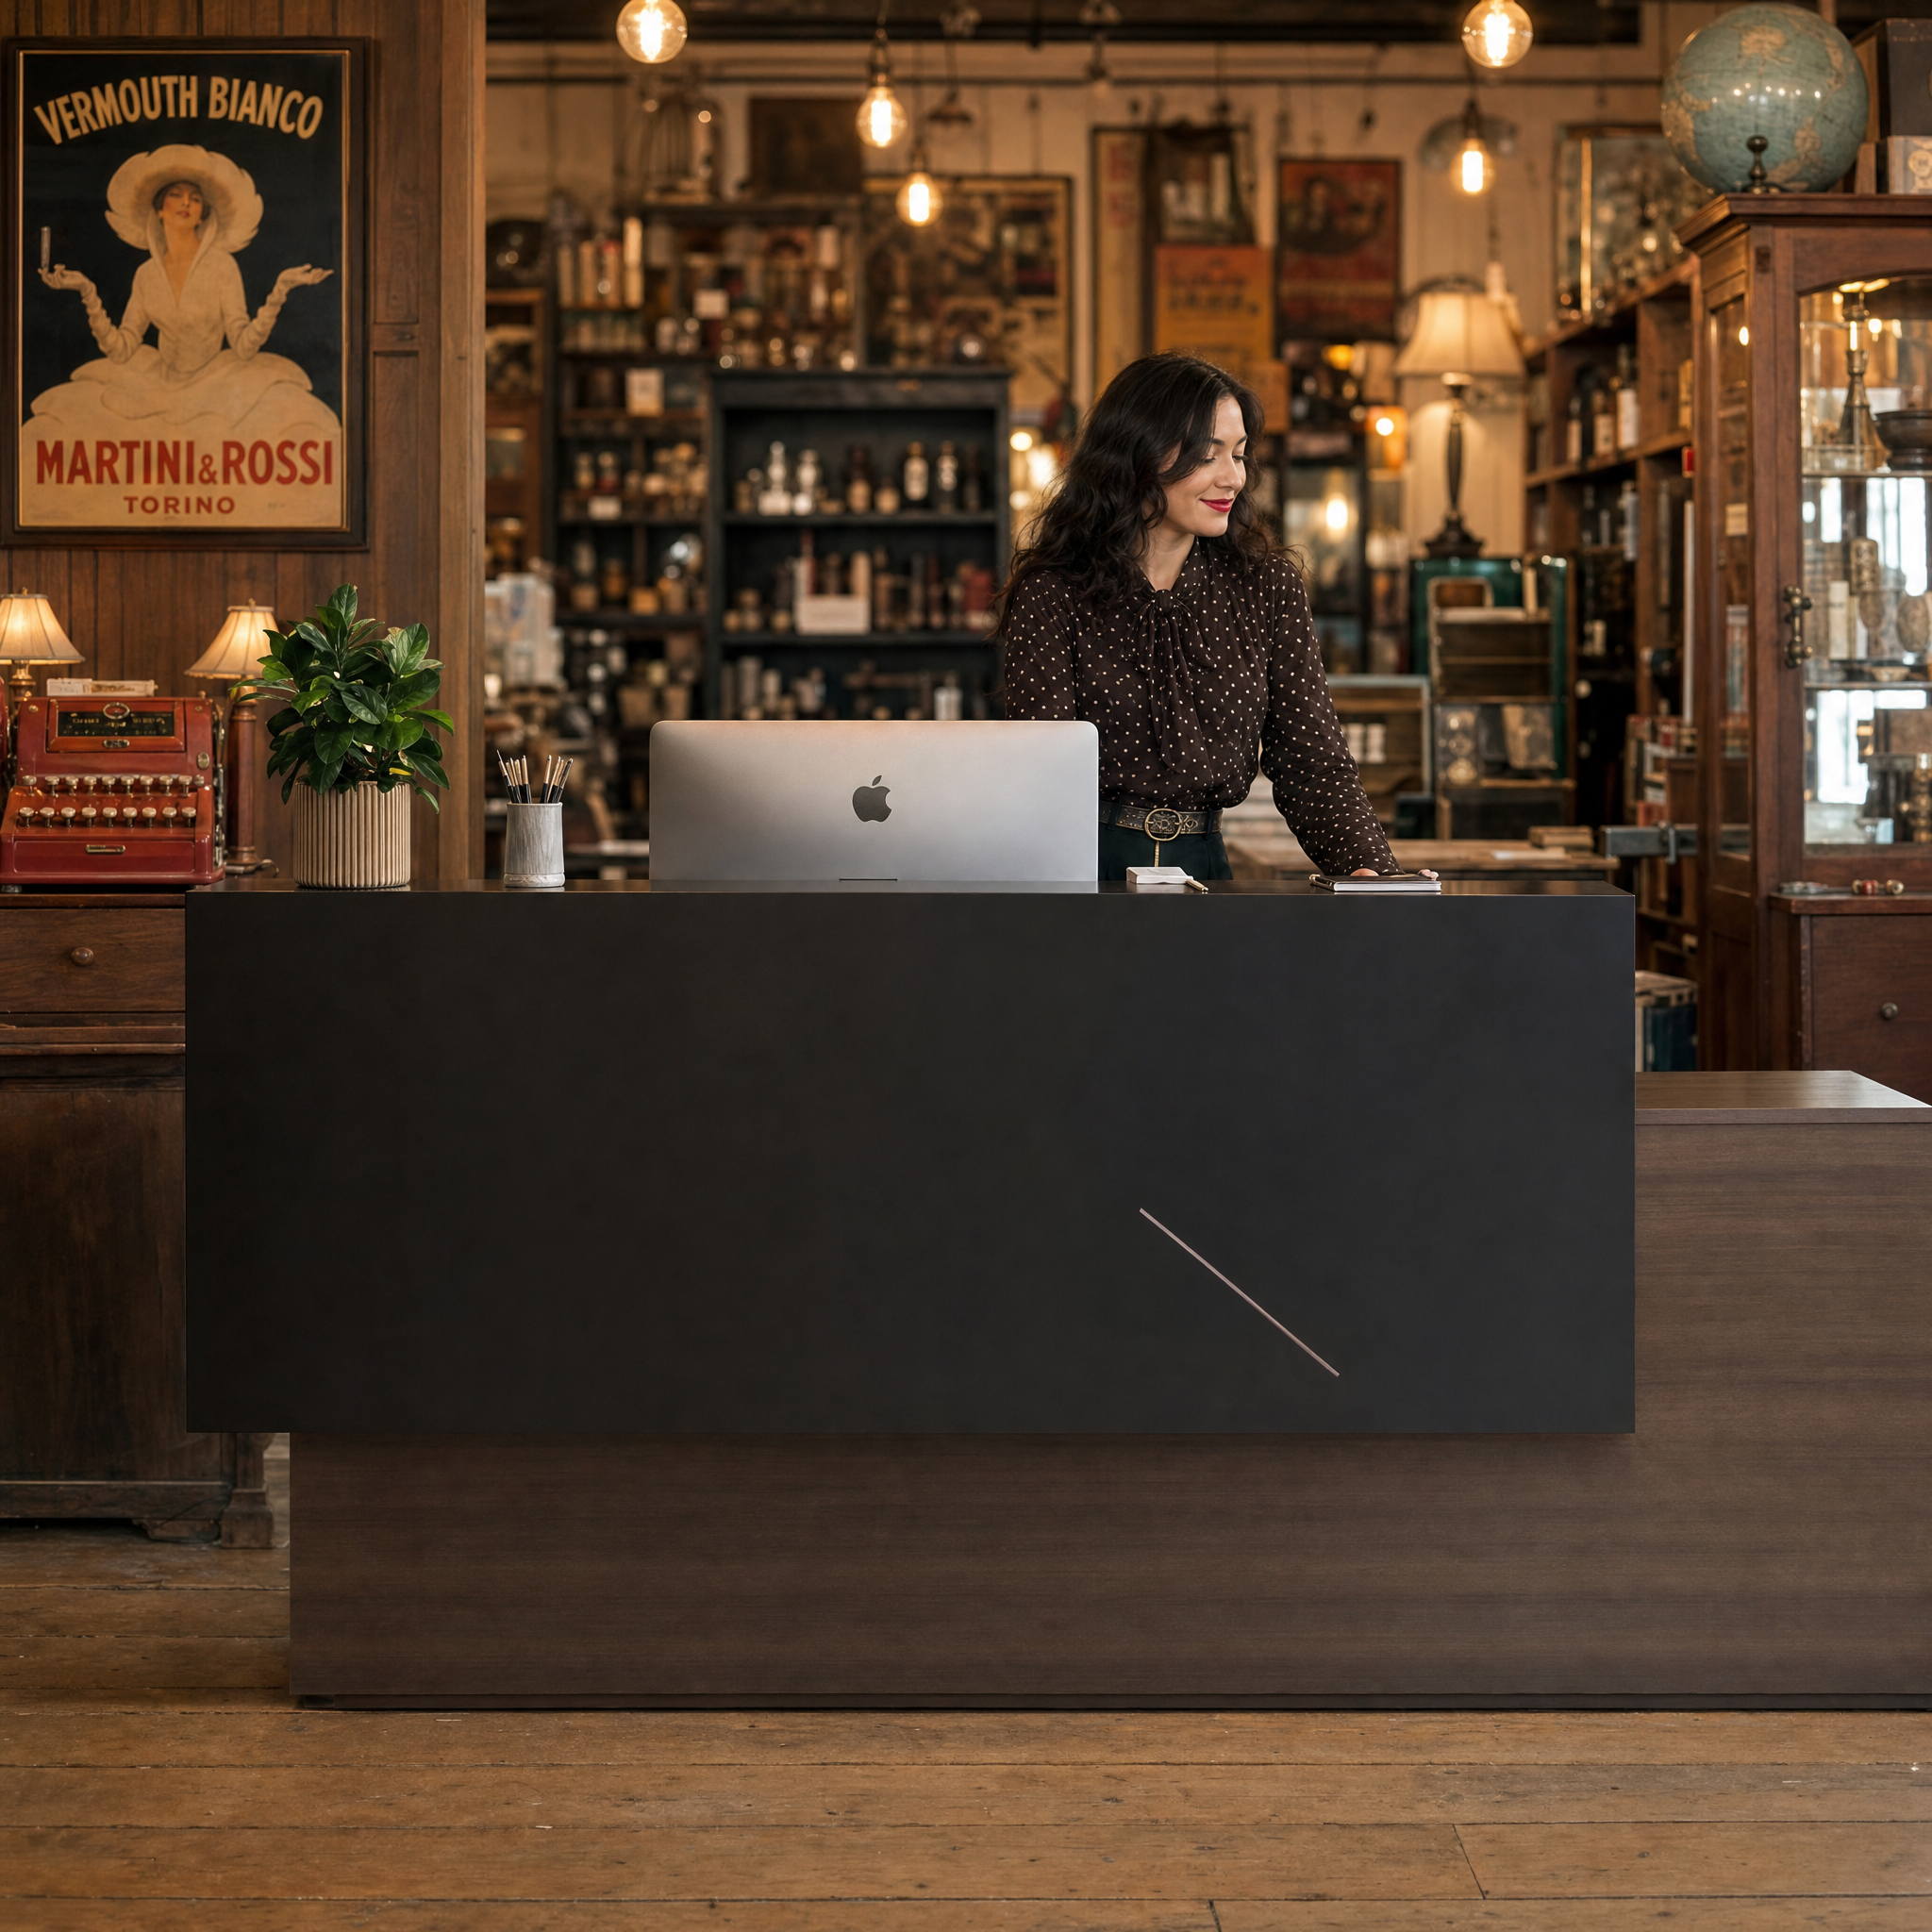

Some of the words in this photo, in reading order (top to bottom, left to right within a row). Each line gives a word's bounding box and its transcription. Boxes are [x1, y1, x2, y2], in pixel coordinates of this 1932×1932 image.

[33, 75, 198, 144] VERMOUTH
[208, 75, 324, 140] BIANCO
[123, 495, 237, 515] TORINO
